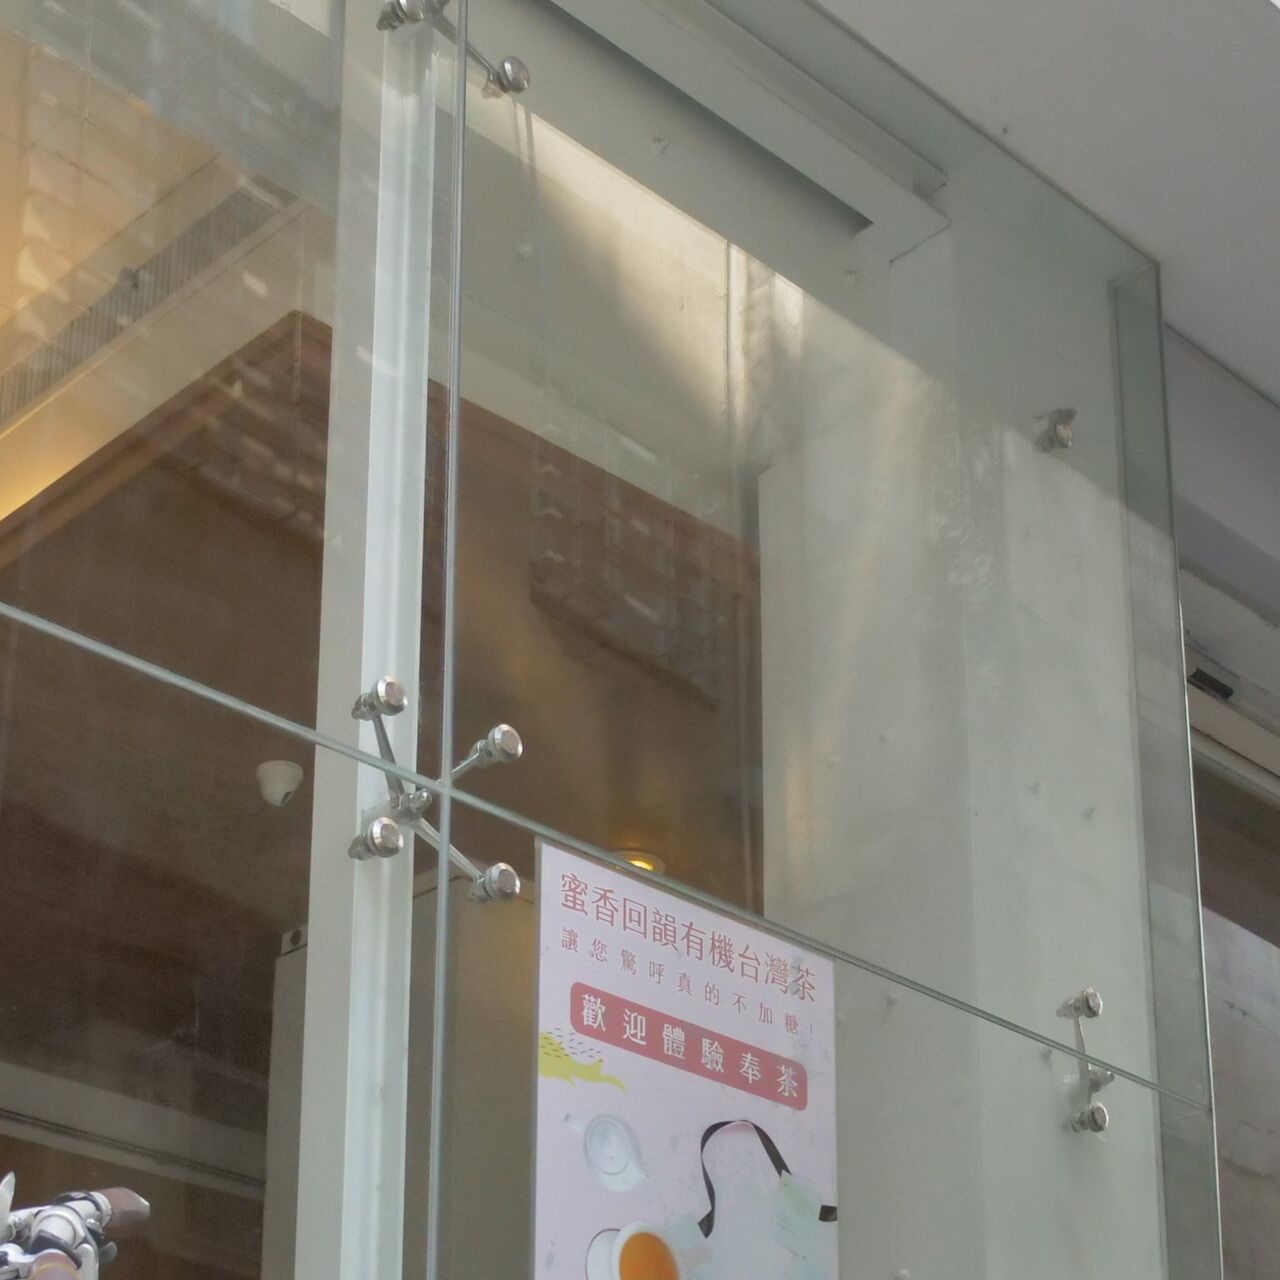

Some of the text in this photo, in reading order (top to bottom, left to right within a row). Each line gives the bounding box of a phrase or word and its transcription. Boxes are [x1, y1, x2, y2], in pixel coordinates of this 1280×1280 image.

[560, 872, 816, 1002] 蜜香回韻有機台灣茶
[581, 993, 799, 1099] 歡迎體驗奉茶
